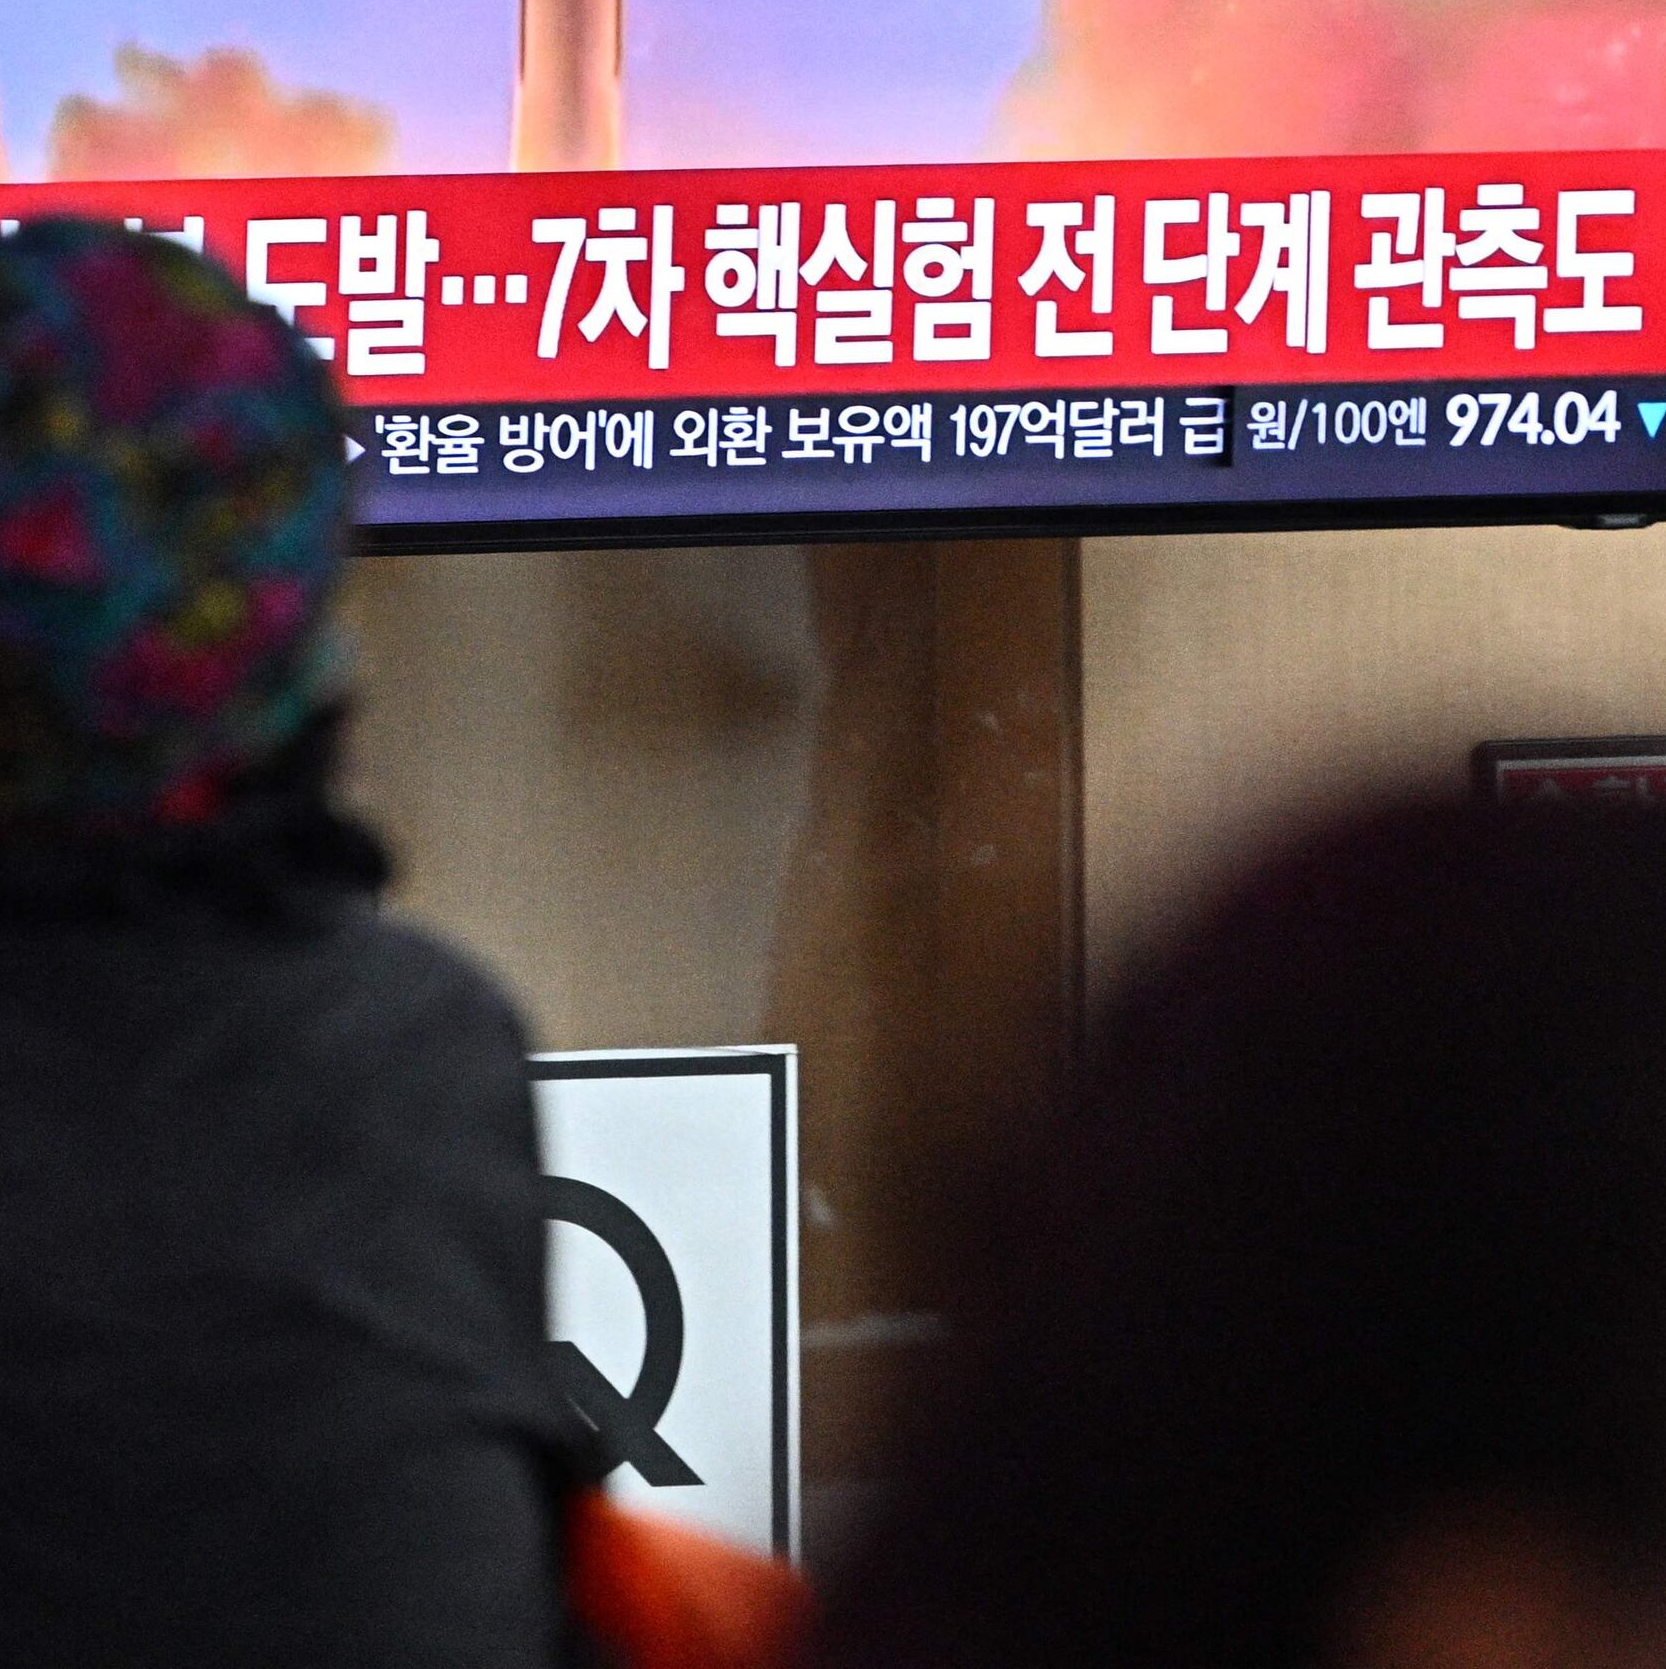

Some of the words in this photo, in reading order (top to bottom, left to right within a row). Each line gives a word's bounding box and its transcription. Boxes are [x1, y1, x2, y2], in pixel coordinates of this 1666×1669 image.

[703, 196, 996, 368] 핵실험
[1017, 194, 1116, 359] 전
[1142, 190, 1332, 356] 단계
[1353, 183, 1644, 351] 관측도
[669, 405, 773, 468] 외환
[781, 402, 933, 464] 보유액
[949, 396, 1166, 460] 197억달러
[1245, 395, 1428, 451] 원/100엔
[1445, 388, 1623, 448] 974.04
